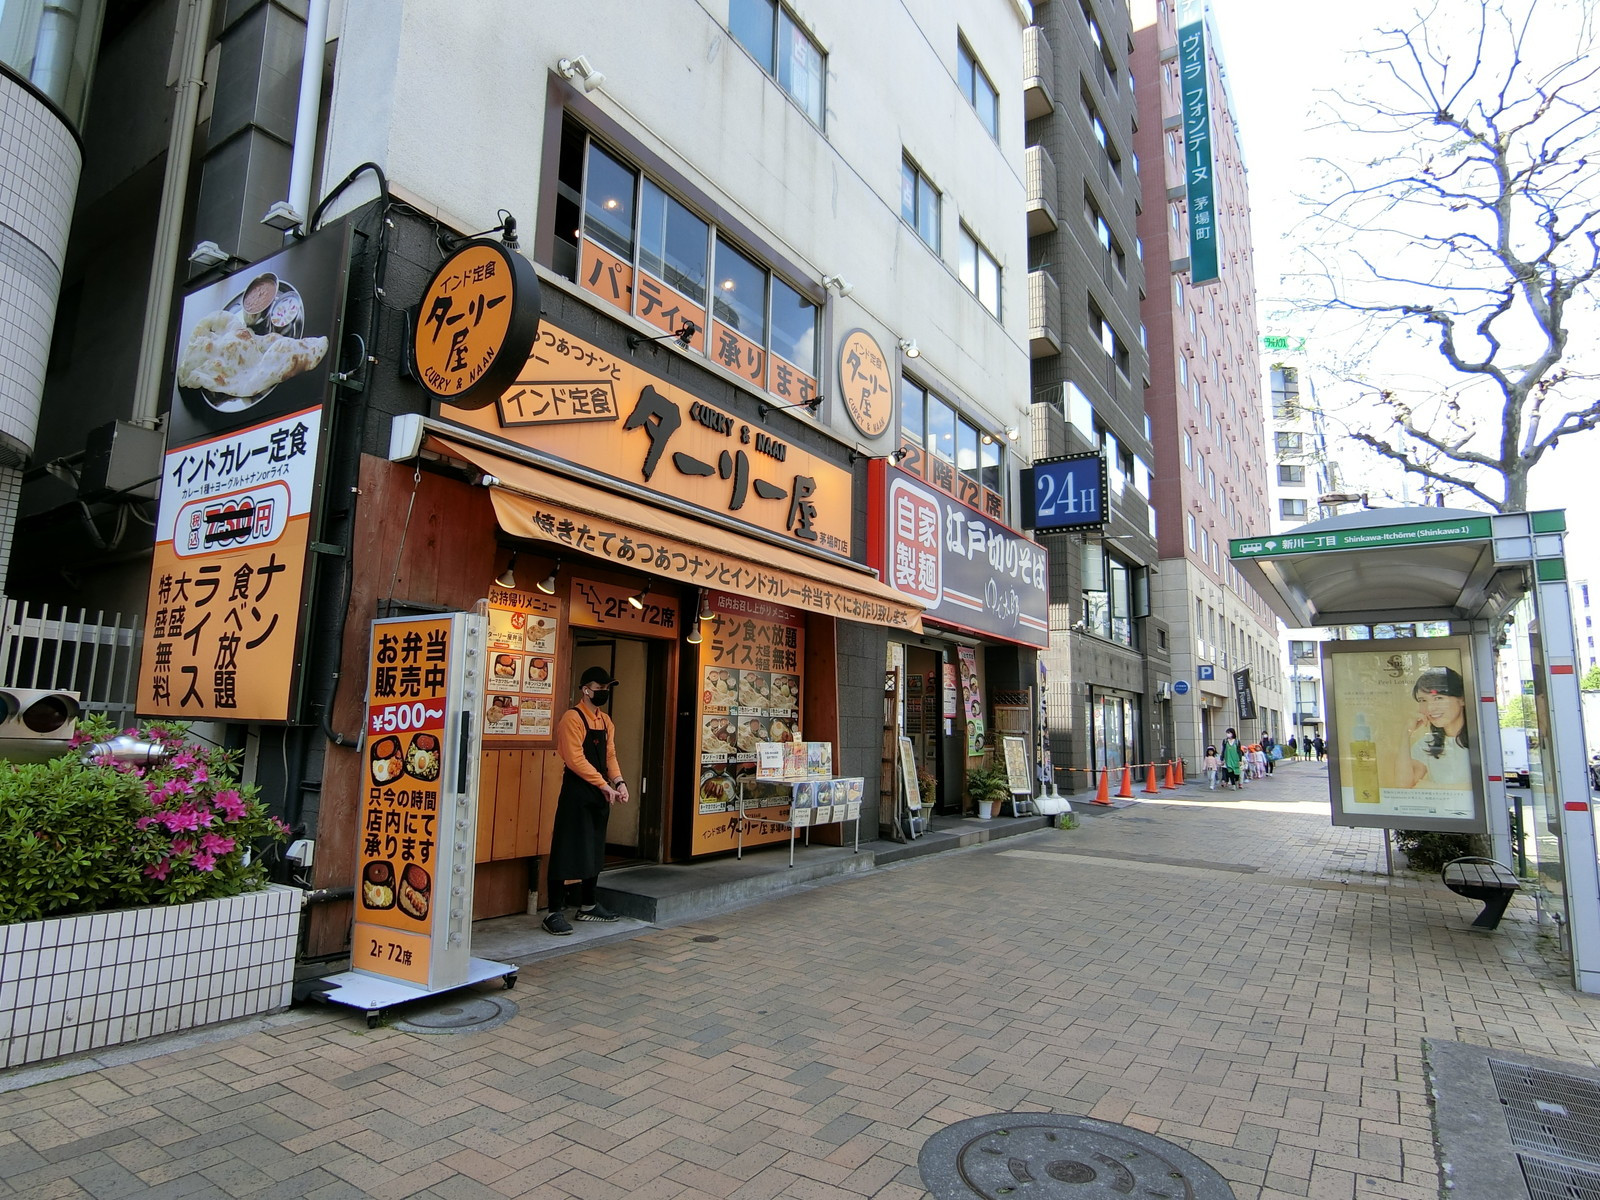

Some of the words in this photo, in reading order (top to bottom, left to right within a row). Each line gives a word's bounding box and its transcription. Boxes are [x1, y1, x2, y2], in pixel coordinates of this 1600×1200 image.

[1182, 31, 1201, 80] ヴィラ
[1186, 87, 1209, 186] フォンテーヌ
[1193, 196, 1210, 240] 茅場町
[440, 260, 497, 293] インド定食
[424, 293, 507, 344] ターリー
[424, 365, 452, 392] CURRY
[455, 377, 463, 390] &
[469, 346, 495, 384] NAAN
[444, 326, 470, 373] 屋
[853, 342, 882, 370] インド定食
[846, 349, 888, 395] ターリー
[506, 386, 612, 417] インド定食
[848, 397, 864, 426] CURRY
[859, 386, 872, 419] 屋
[689, 400, 735, 437] CURRY
[740, 425, 751, 444] &
[755, 432, 787, 462] NAAN
[172, 421, 309, 488] インドカレー定食
[622, 384, 818, 541] ターリー屋
[1037, 470, 1097, 517] 24H
[819, 531, 848, 554] 茅場町店
[897, 496, 938, 550] 自家
[1282, 535, 1336, 550] 新川一丁目
[1416, 527, 1460, 539] (Shinkawa
[1460, 525, 1470, 535] 1)
[896, 541, 938, 595] 製麺
[946, 504, 1046, 593] 江戸切りそば
[167, 571, 192, 638] 大盛
[245, 552, 286, 650] ナン
[489, 589, 557, 612] お持帰りメニュー
[717, 595, 796, 620] 店内お召し上がりメニュー
[180, 565, 222, 709] ライス
[213, 562, 254, 709] 食べ放題
[376, 628, 448, 665] お弁当
[711, 613, 798, 650] ナン食べ放題
[152, 641, 173, 707] 無料
[711, 639, 754, 666] ライス
[772, 647, 797, 672] 無料
[1201, 666, 1212, 679] P
[374, 663, 446, 699] 販売中
[368, 787, 437, 811] 只今の時間
[365, 807, 436, 837] 店内にて
[364, 832, 435, 864] 承ります
[370, 939, 383, 958] 2F
[387, 942, 413, 966] 72席
